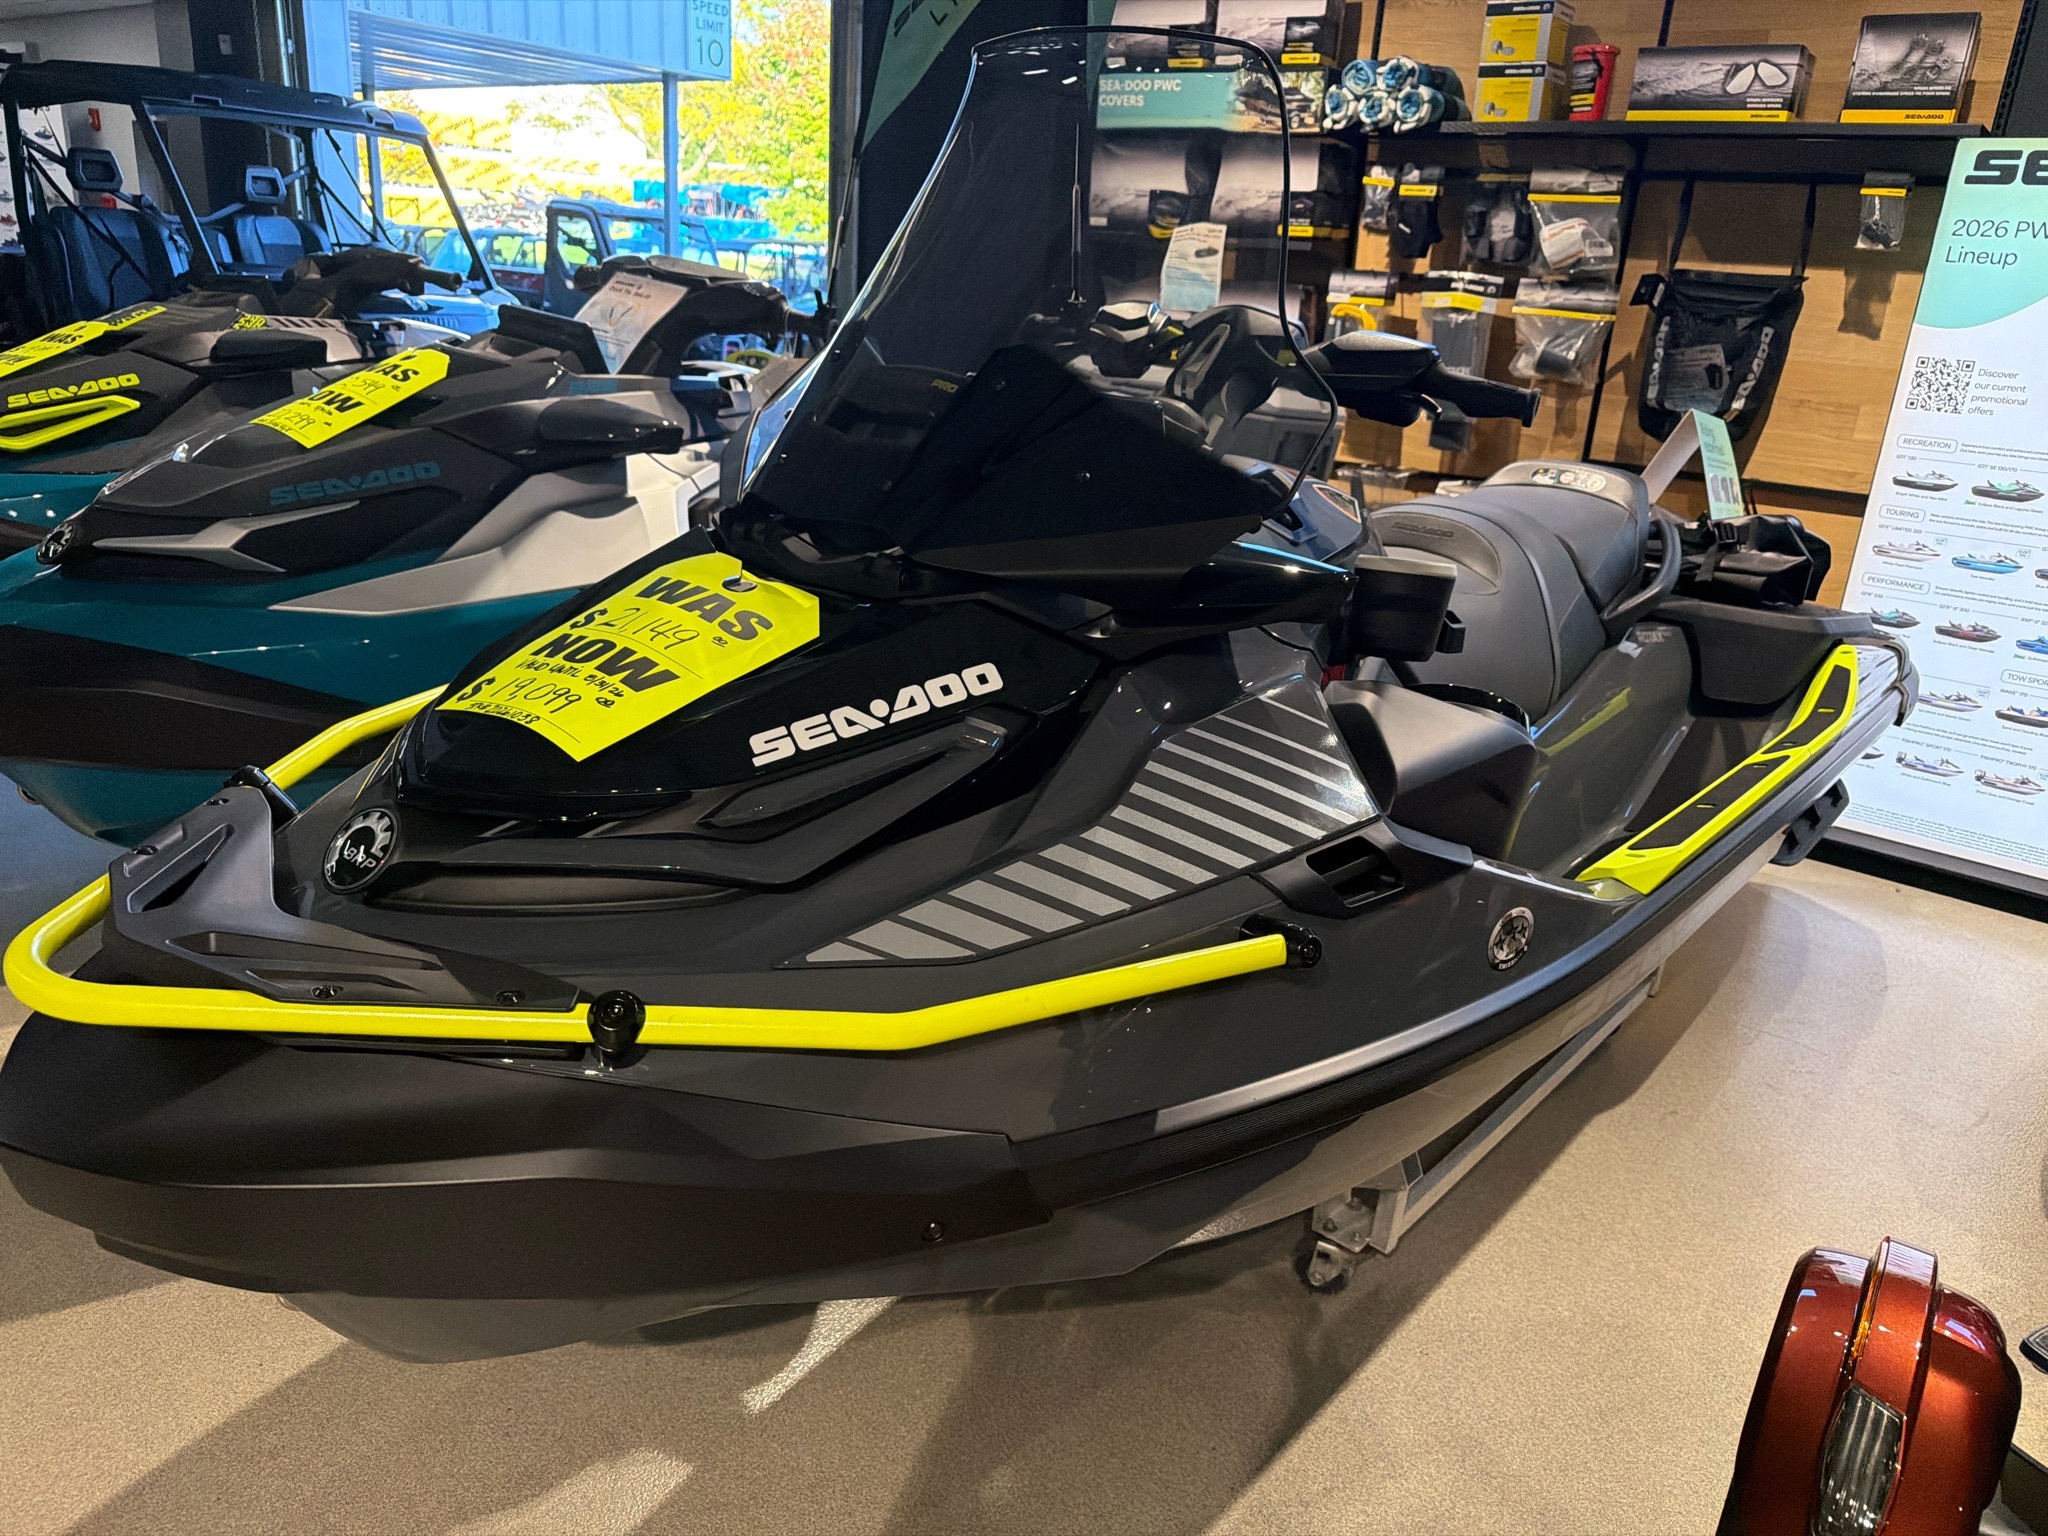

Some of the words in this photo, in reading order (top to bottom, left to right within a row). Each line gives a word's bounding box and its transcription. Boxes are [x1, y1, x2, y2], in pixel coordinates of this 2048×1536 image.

[692, 0, 729, 17] SPEED
[696, 17, 725, 34] LIMIT
[697, 36, 723, 67] 10
[1100, 79, 1150, 92] SEA-DOO
[1152, 79, 1182, 91] PWC
[1099, 95, 1144, 107] COVERS
[1952, 219, 2010, 238] 2026
[1945, 246, 2018, 270] Lineup
[1978, 368, 2019, 379] Discover
[931, 379, 959, 393] PRO
[1974, 382, 1991, 390] our
[1991, 383, 2027, 393] current
[307, 389, 365, 413] OW
[1970, 394, 2028, 406] promotional
[1967, 406, 1994, 416] offers
[1903, 438, 1952, 449] RECREATION
[1885, 508, 1920, 519] TOURING
[1867, 576, 1925, 591] PERFORMANCE
[634, 576, 774, 641] WAS
[595, 607, 700, 650] 21,149
[530, 633, 681, 692] NOW
[2007, 672, 2028, 683] TOW
[489, 677, 582, 713] 19,099
[343, 847, 377, 869] BRP
